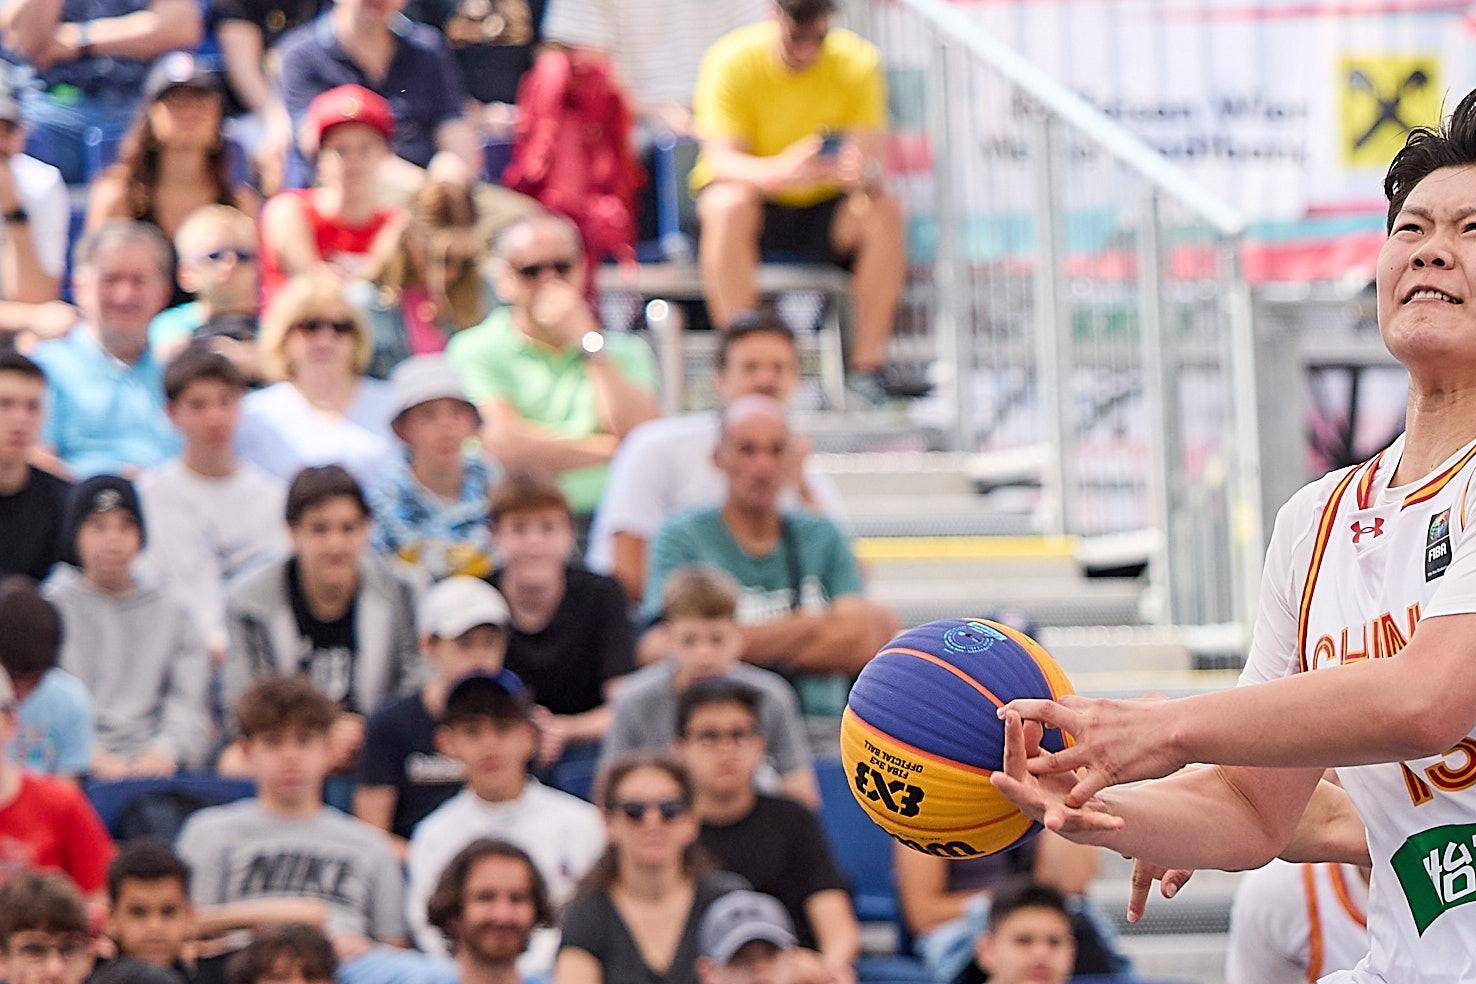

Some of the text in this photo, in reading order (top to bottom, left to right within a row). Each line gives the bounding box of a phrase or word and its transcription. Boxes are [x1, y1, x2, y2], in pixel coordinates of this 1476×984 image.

[1428, 542, 1448, 563] FIBA
[1312, 601, 1422, 671] CHIN
[864, 739, 924, 774] OFFICIAL BALL
[887, 763, 909, 780] FIBA
[854, 761, 925, 818] 3X3
